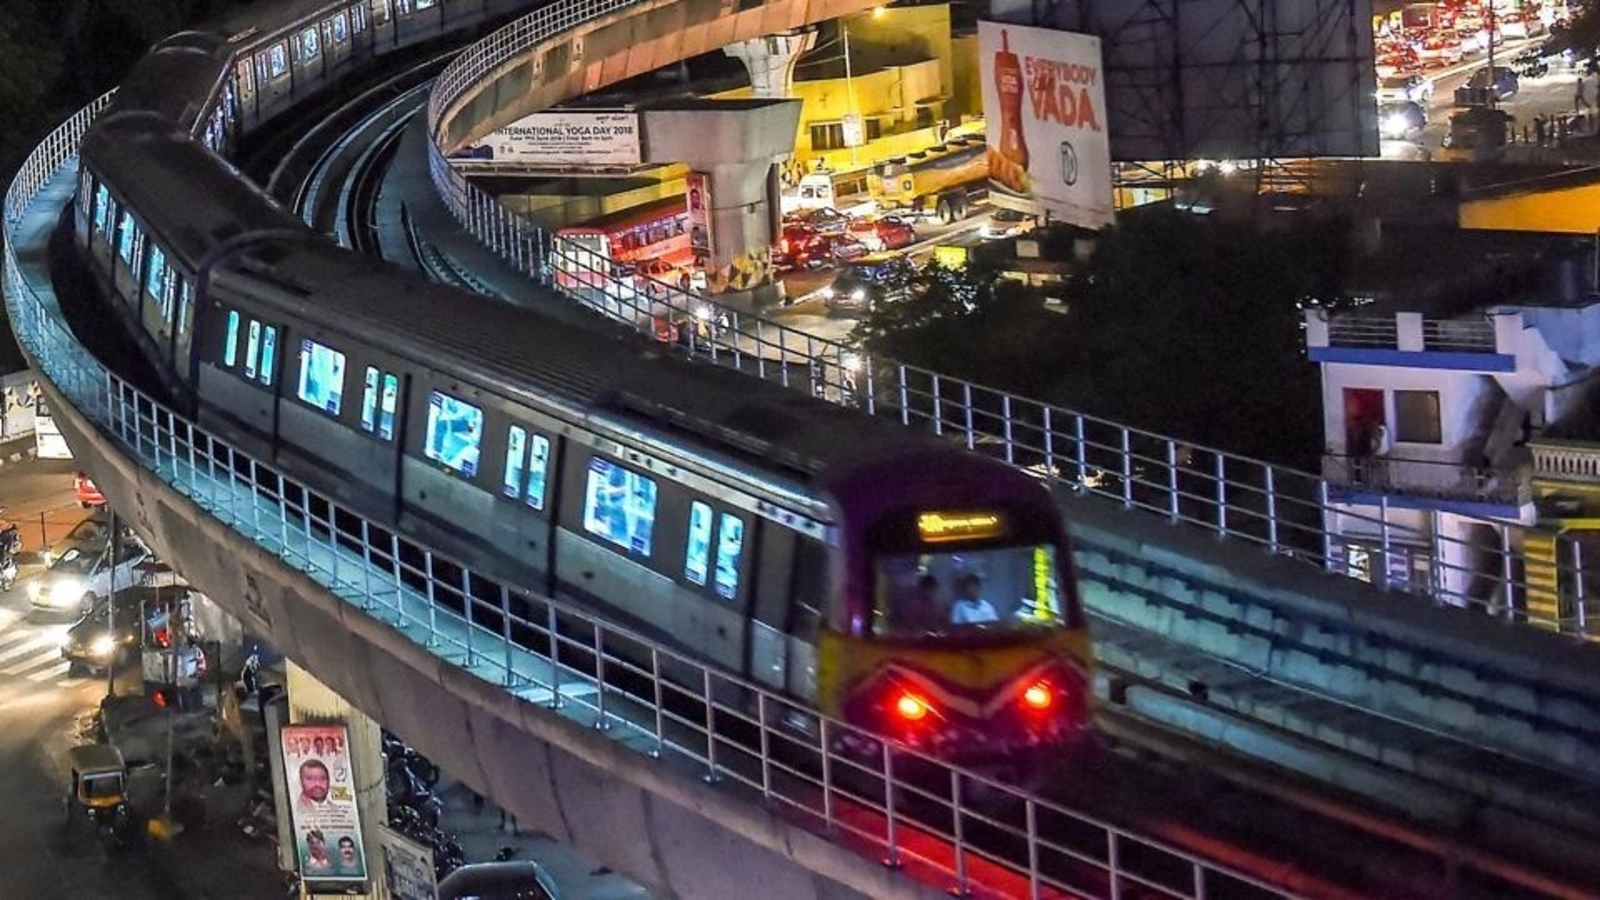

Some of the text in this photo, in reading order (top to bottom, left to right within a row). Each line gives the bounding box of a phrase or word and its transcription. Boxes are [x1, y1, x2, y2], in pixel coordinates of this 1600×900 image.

[565, 126, 591, 136] YOGA
[592, 126, 612, 135] DAY
[613, 126, 633, 135] 2018
